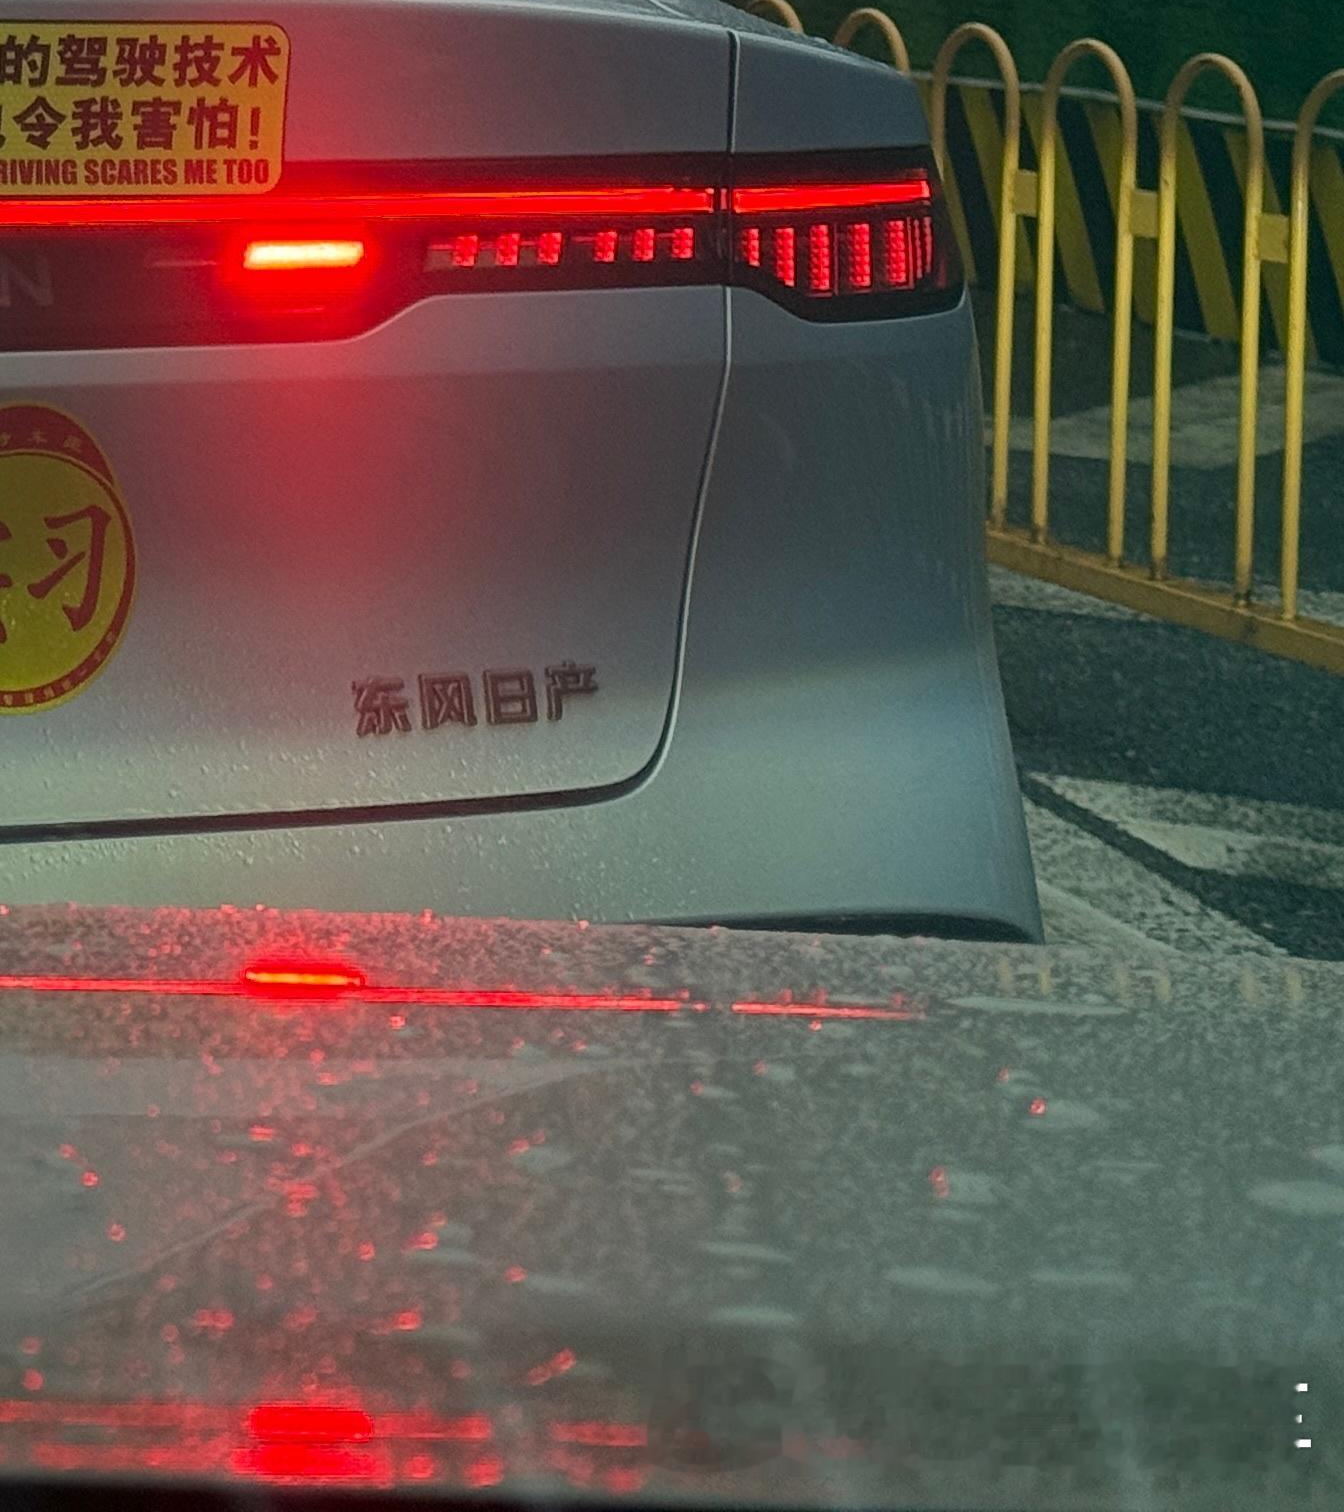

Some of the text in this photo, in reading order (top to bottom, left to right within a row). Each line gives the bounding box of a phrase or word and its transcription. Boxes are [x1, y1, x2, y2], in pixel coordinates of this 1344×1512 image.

[84, 158, 179, 186] SCARES
[184, 159, 215, 186] ME
[223, 159, 270, 186] TOO
[351, 661, 599, 737] 东风日产
